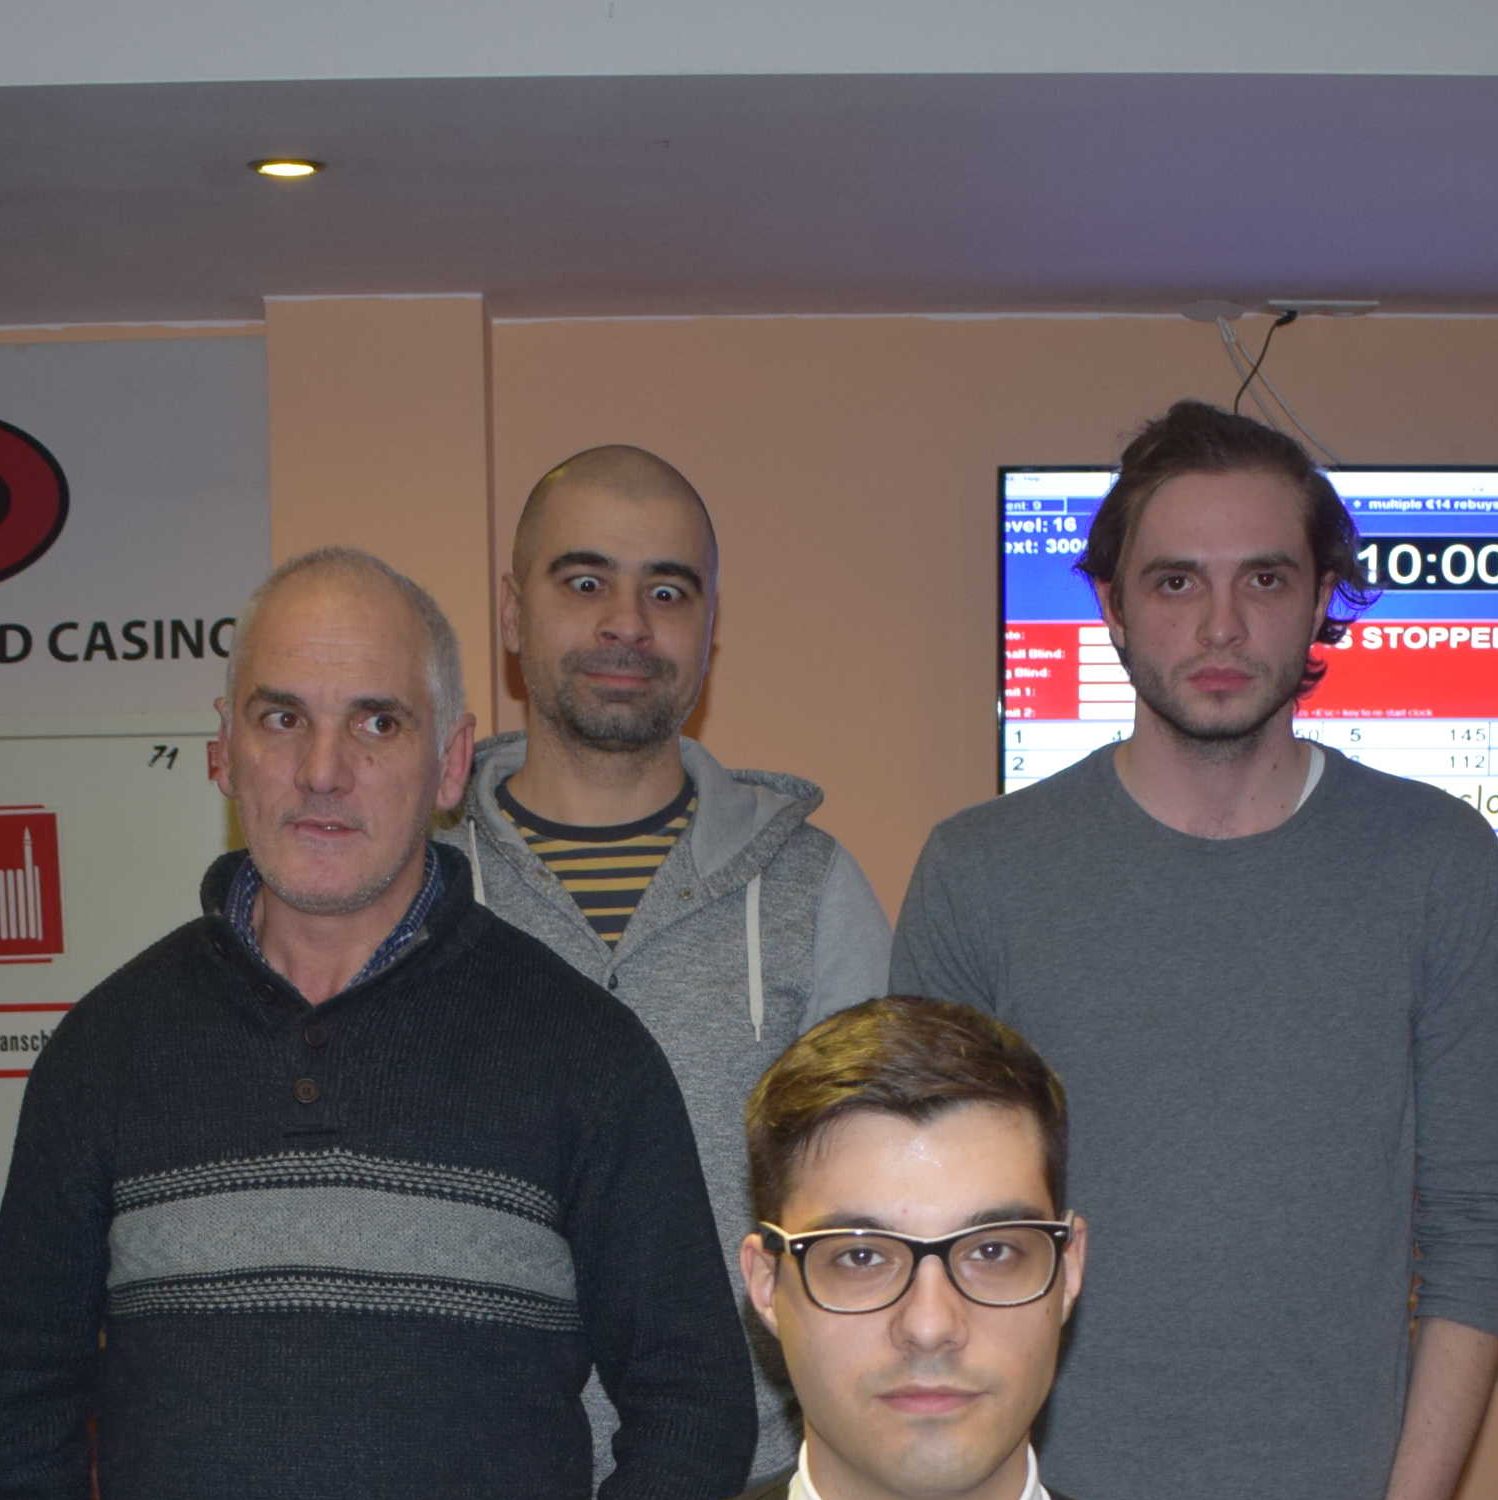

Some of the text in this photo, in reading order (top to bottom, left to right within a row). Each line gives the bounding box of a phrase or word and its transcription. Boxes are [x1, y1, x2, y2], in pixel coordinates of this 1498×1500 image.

[1368, 499, 1423, 511] multiple
[1052, 516, 1077, 532] 16
[1350, 728, 1486, 743] 5 145
[1012, 756, 1025, 771] 2
[1450, 755, 1485, 769] 112
